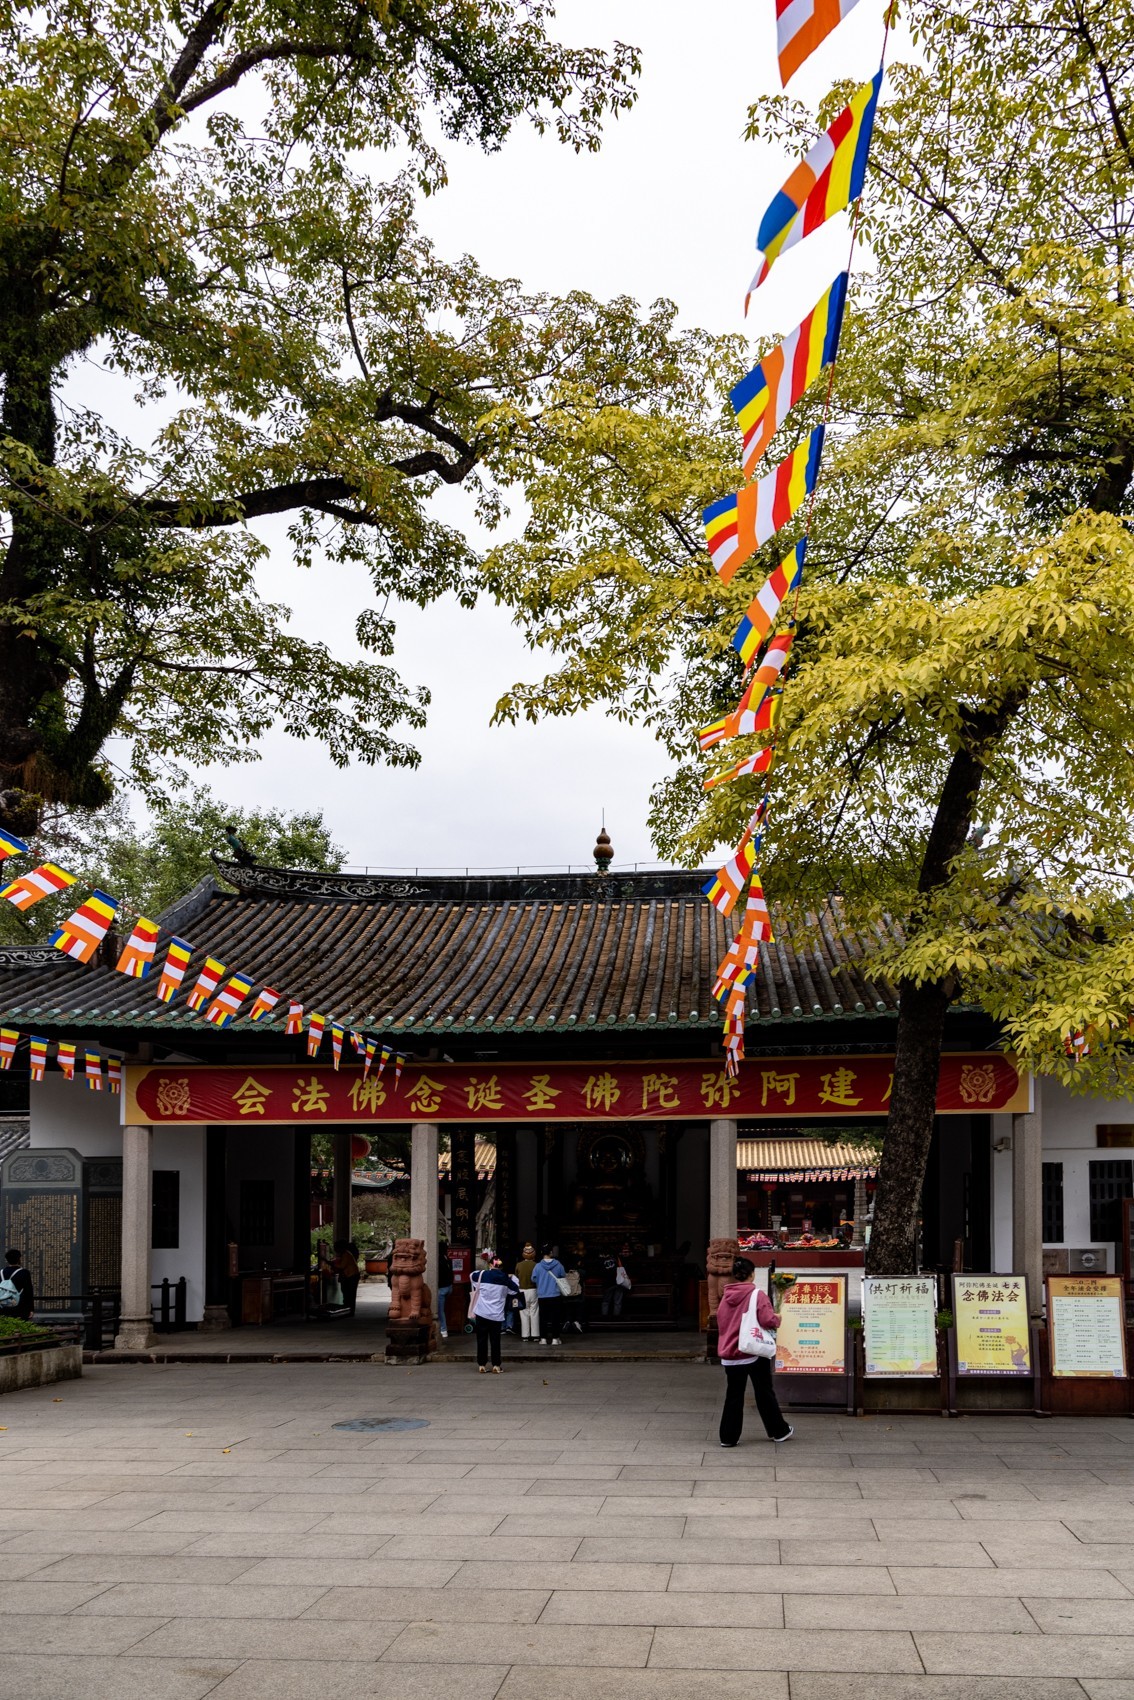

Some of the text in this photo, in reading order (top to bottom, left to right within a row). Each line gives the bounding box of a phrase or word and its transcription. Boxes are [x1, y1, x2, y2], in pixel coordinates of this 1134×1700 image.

[231, 1067, 894, 1115] 建阿弥陀佛圣诞念佛法会
[814, 1285, 831, 1293] 15天
[869, 1283, 929, 1295] 供灯祈福
[788, 1293, 833, 1304] 祈福法会
[962, 1290, 1019, 1302] 念佛法会
